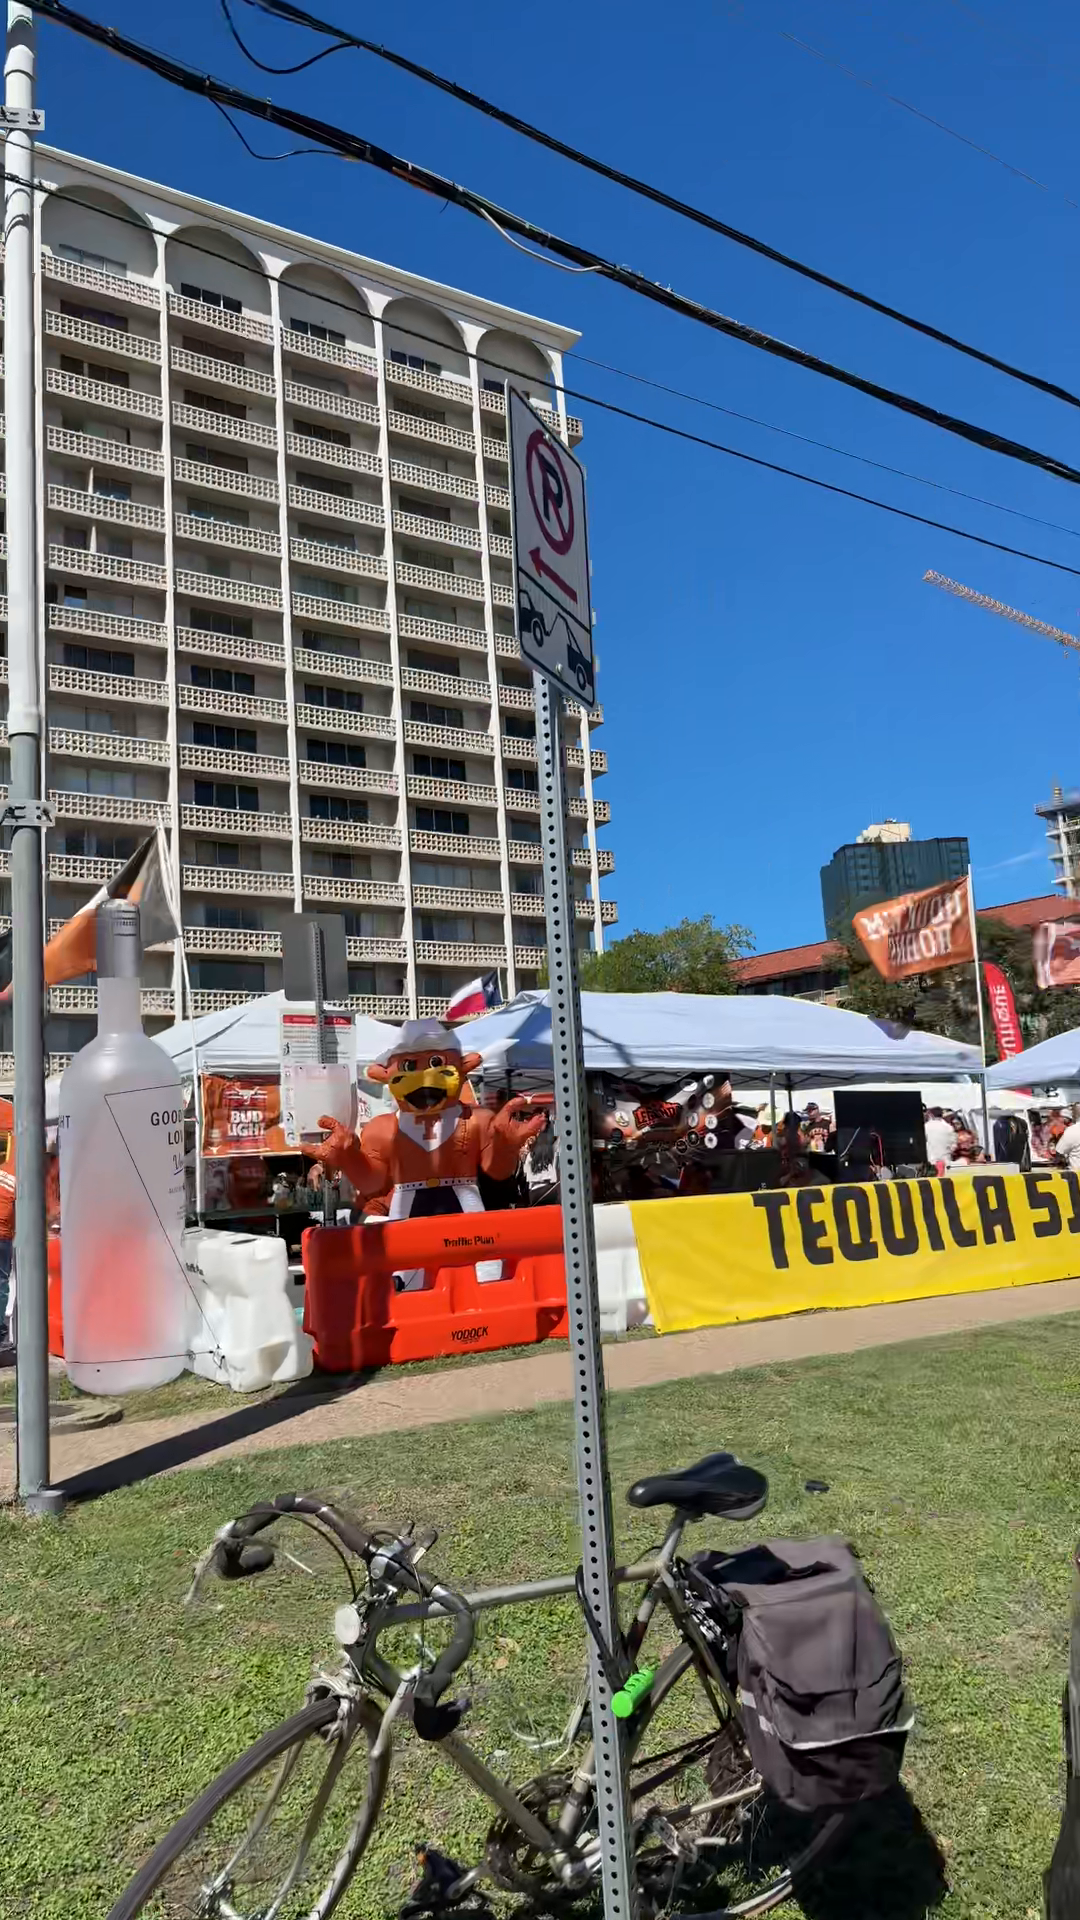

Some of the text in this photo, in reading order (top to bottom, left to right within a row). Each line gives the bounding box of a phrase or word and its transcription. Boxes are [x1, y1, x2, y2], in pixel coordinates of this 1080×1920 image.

[230, 1110, 264, 1123] BUD
[227, 1123, 266, 1137] LIGHT
[752, 1175, 1016, 1270] TEQUILA
[443, 1237, 473, 1247] Traffic
[451, 1326, 489, 1341] YODOCK
